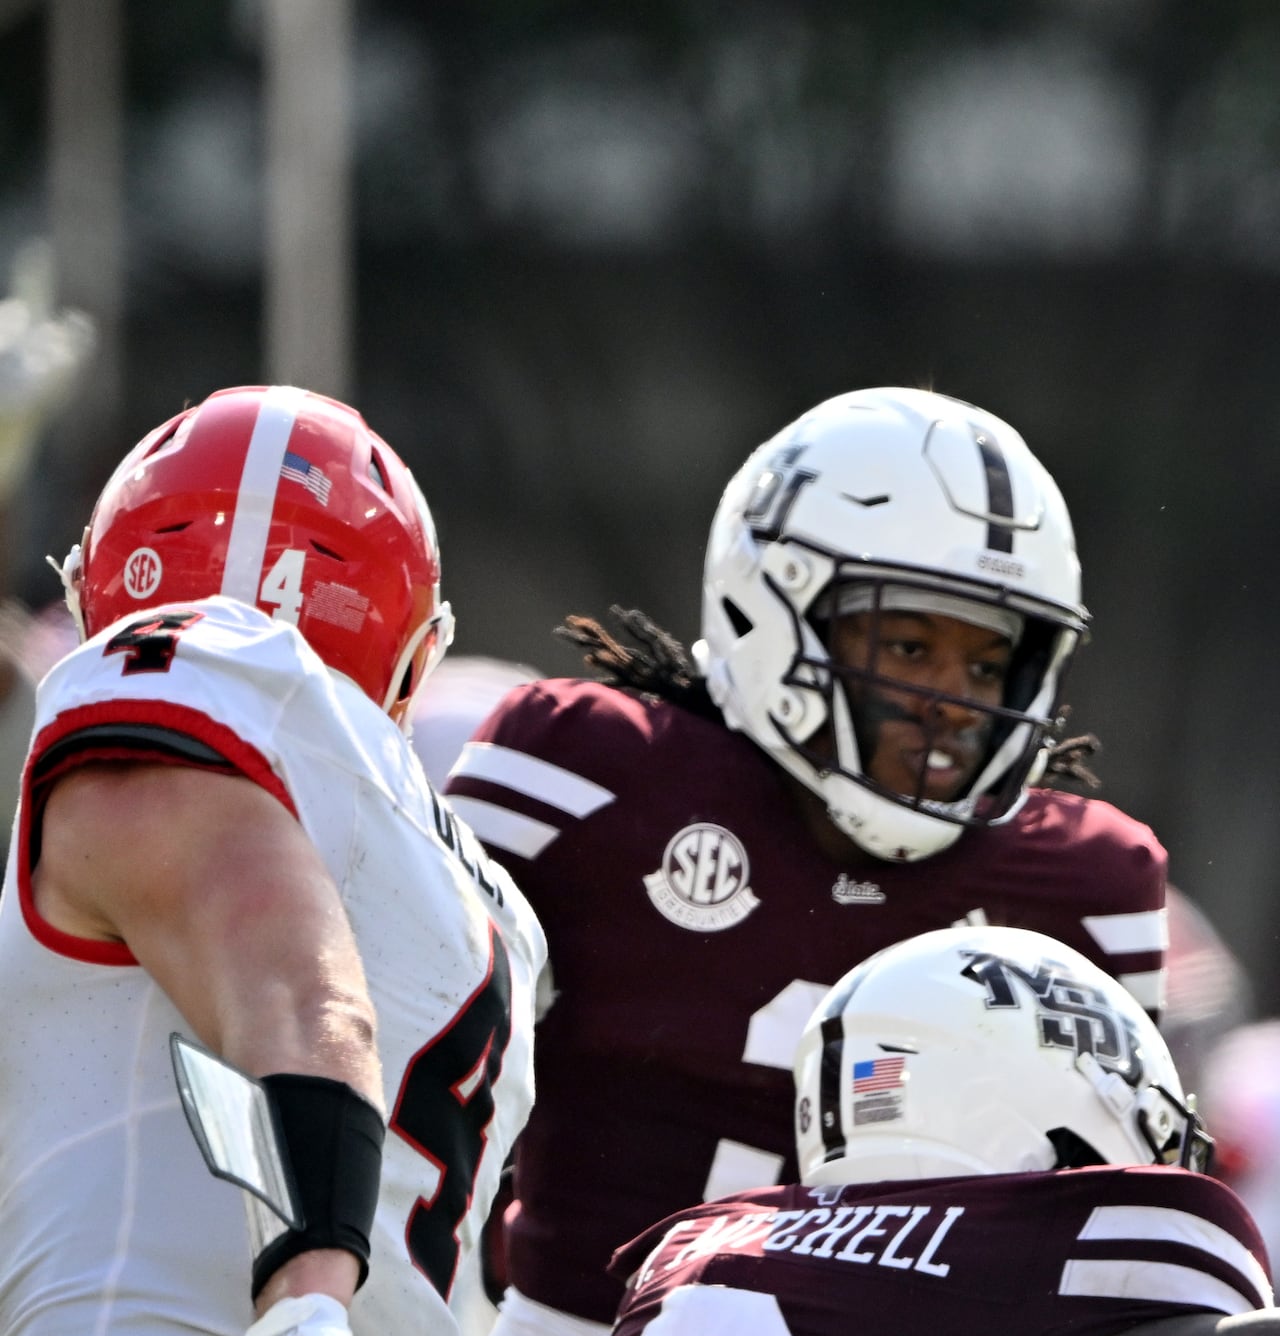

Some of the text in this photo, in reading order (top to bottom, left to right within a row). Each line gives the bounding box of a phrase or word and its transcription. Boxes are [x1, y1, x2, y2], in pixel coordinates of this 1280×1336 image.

[127, 552, 158, 594] SEC
[259, 548, 306, 627] 4
[102, 609, 207, 677] 4
[669, 828, 743, 905] SEC
[388, 915, 513, 1304] 4
